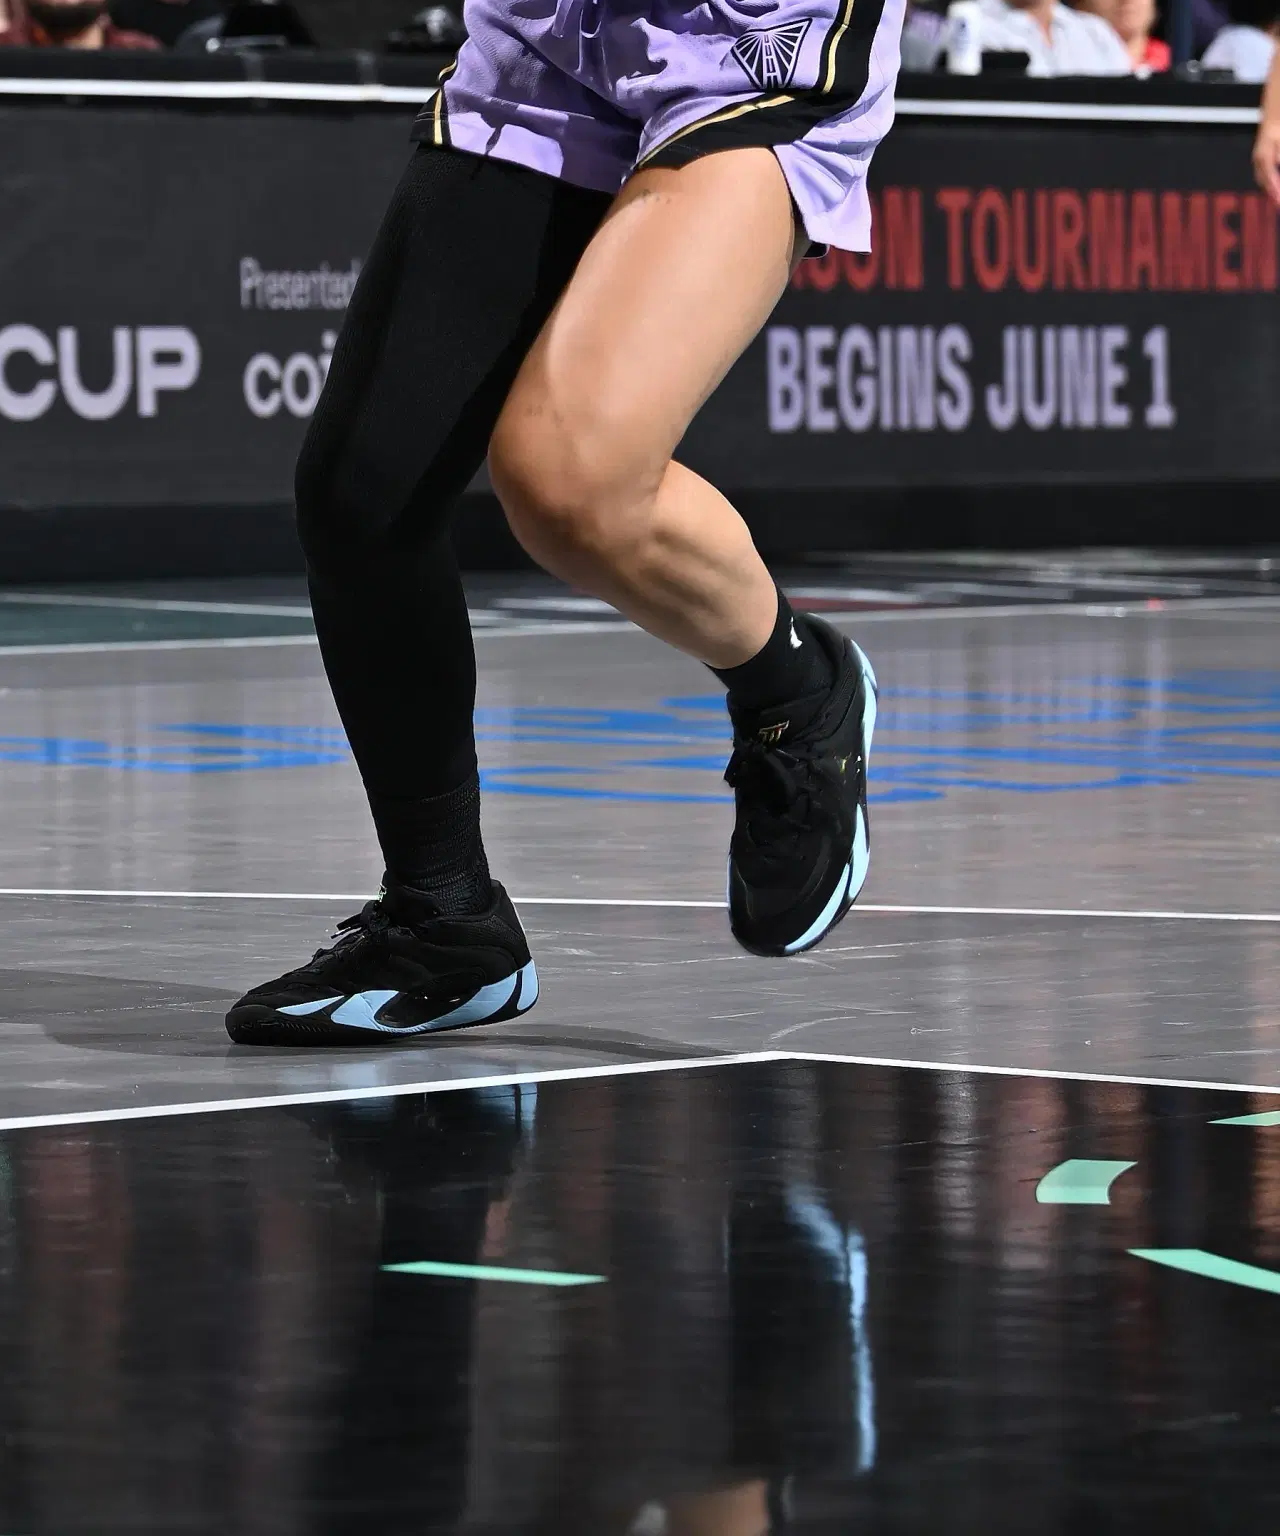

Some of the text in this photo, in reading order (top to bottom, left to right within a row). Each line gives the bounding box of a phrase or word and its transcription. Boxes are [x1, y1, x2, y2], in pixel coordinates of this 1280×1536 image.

[766, 323, 1175, 433] BEGINS JUNE 1
